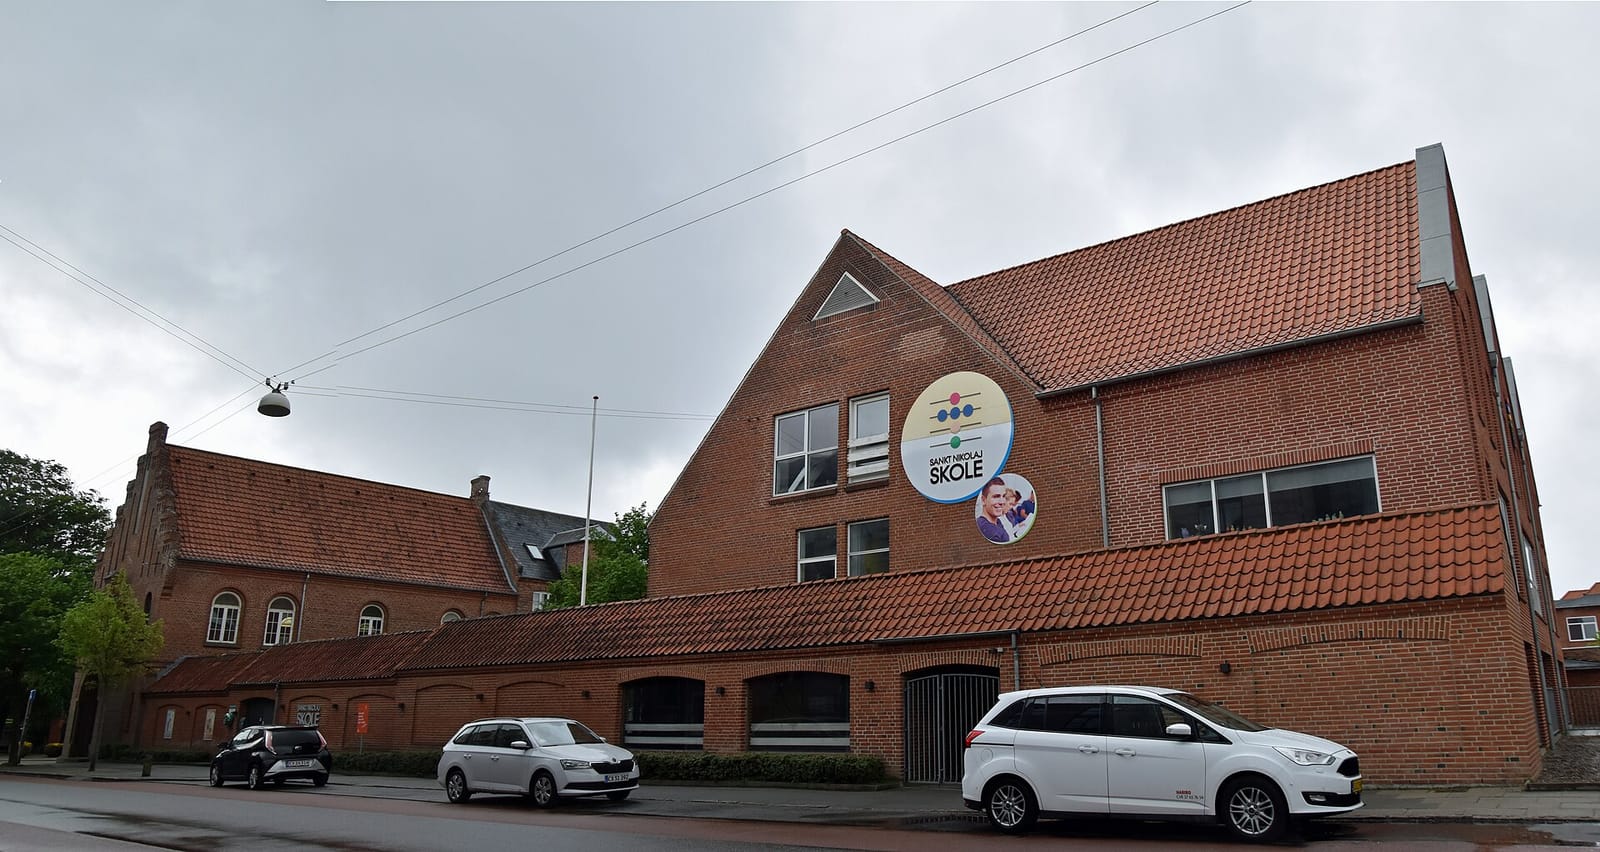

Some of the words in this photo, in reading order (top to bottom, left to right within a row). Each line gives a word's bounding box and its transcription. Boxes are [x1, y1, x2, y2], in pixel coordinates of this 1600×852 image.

[930, 456, 951, 466] SANKT
[953, 450, 983, 463] NIKOLAJ
[930, 459, 983, 485] SKOLE
[296, 712, 320, 727] SKOLE
